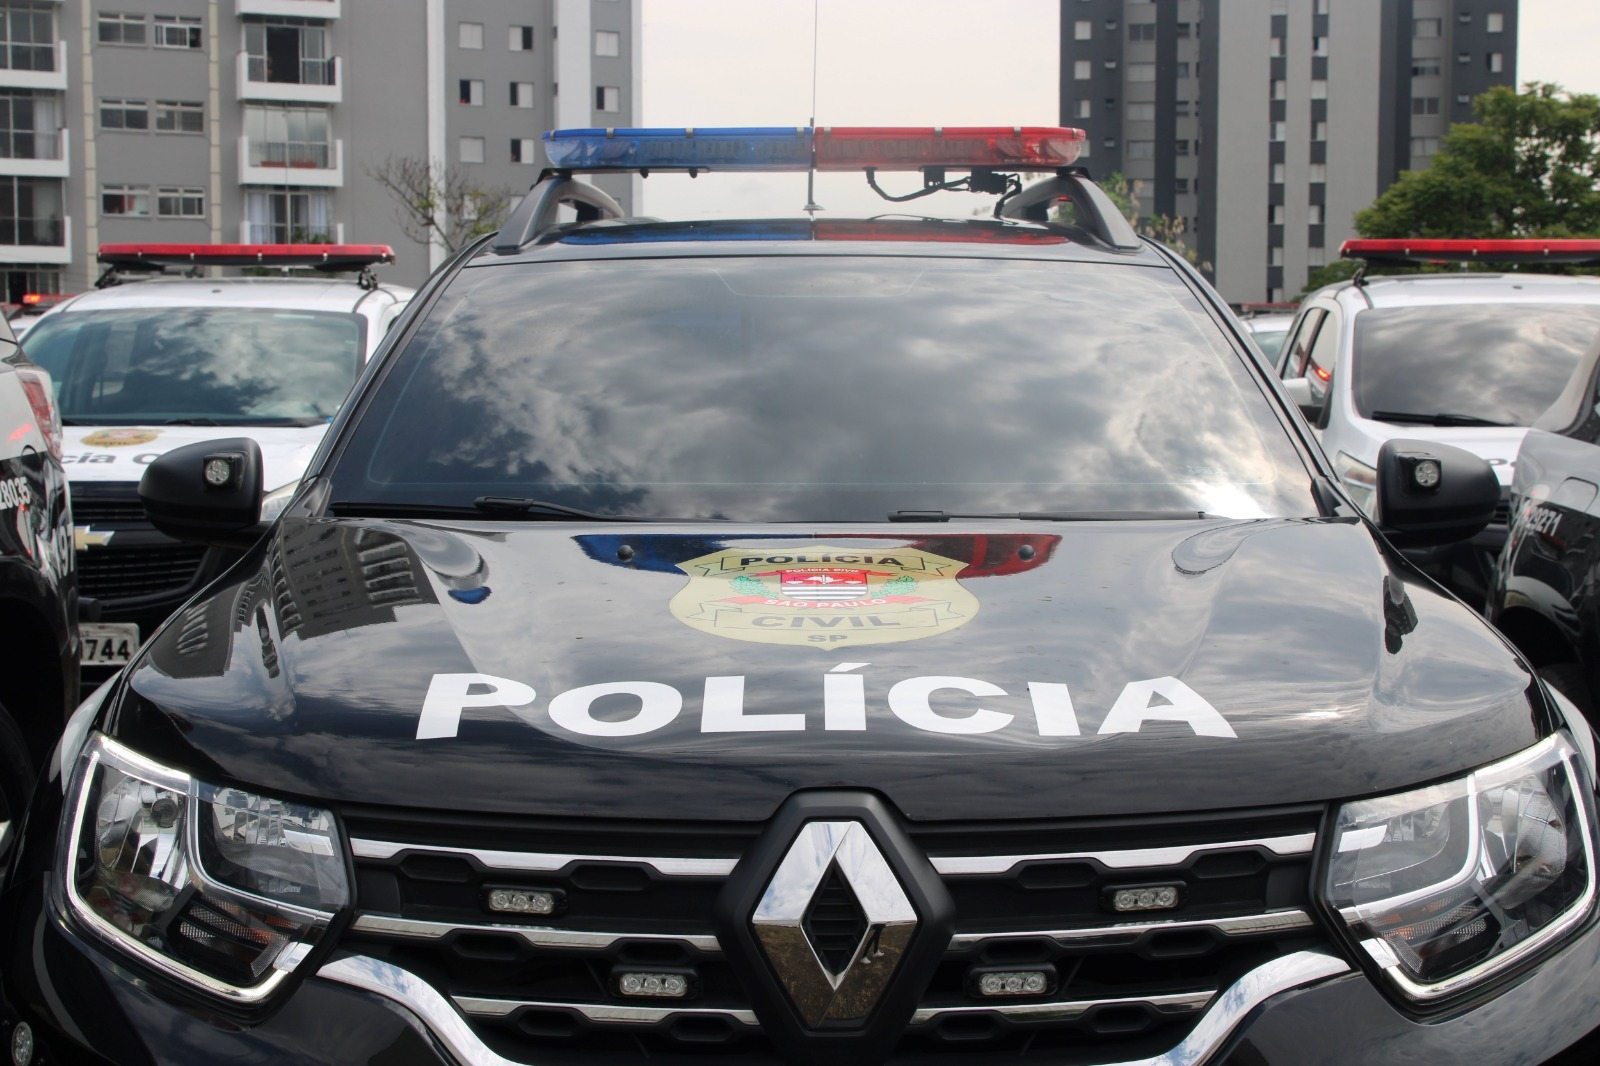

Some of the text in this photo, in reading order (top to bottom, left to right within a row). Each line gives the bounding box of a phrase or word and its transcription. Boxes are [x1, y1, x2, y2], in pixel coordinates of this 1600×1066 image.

[816, 599, 887, 608] PAULO
[751, 615, 902, 628] CIVIL
[807, 634, 849, 642] SP
[80, 638, 131, 660] 744
[415, 662, 1239, 740] POLÍCIA
